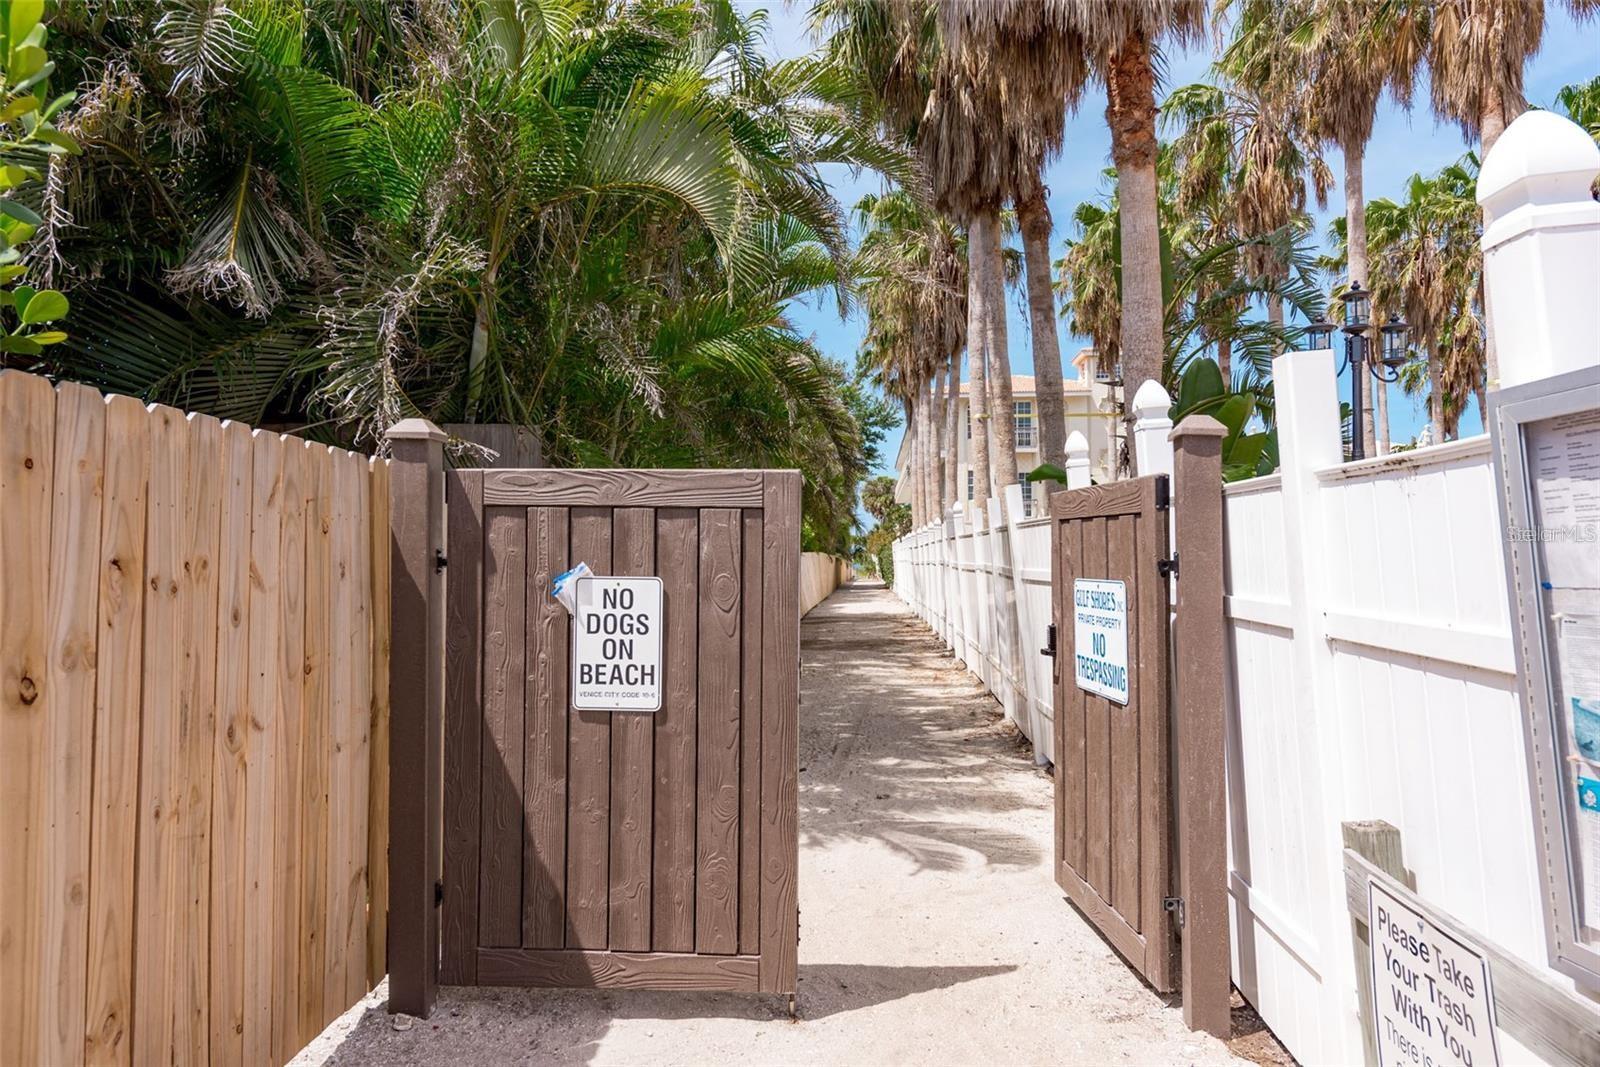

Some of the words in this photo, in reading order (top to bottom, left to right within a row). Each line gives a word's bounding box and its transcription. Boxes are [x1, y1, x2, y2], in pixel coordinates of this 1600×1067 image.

[603, 588, 634, 610] NO
[1076, 589, 1089, 607] GULF
[1091, 591, 1116, 611] SHORES
[587, 613, 650, 635] DOGS
[1077, 612, 1095, 626] PRIVATE
[1096, 615, 1121, 630] PROPERTY
[602, 638, 633, 660] ON
[1092, 632, 1106, 658] NO
[580, 664, 655, 686] BEACH
[1077, 654, 1126, 692] TRESPASSING
[1377, 905, 1430, 963] Please
[1431, 943, 1475, 999] Take
[1382, 943, 1420, 992] Your
[1423, 973, 1477, 1038] Trash
[1391, 984, 1432, 1038] With
[1436, 1016, 1473, 1067] You
[1384, 1015, 1419, 1064] There
